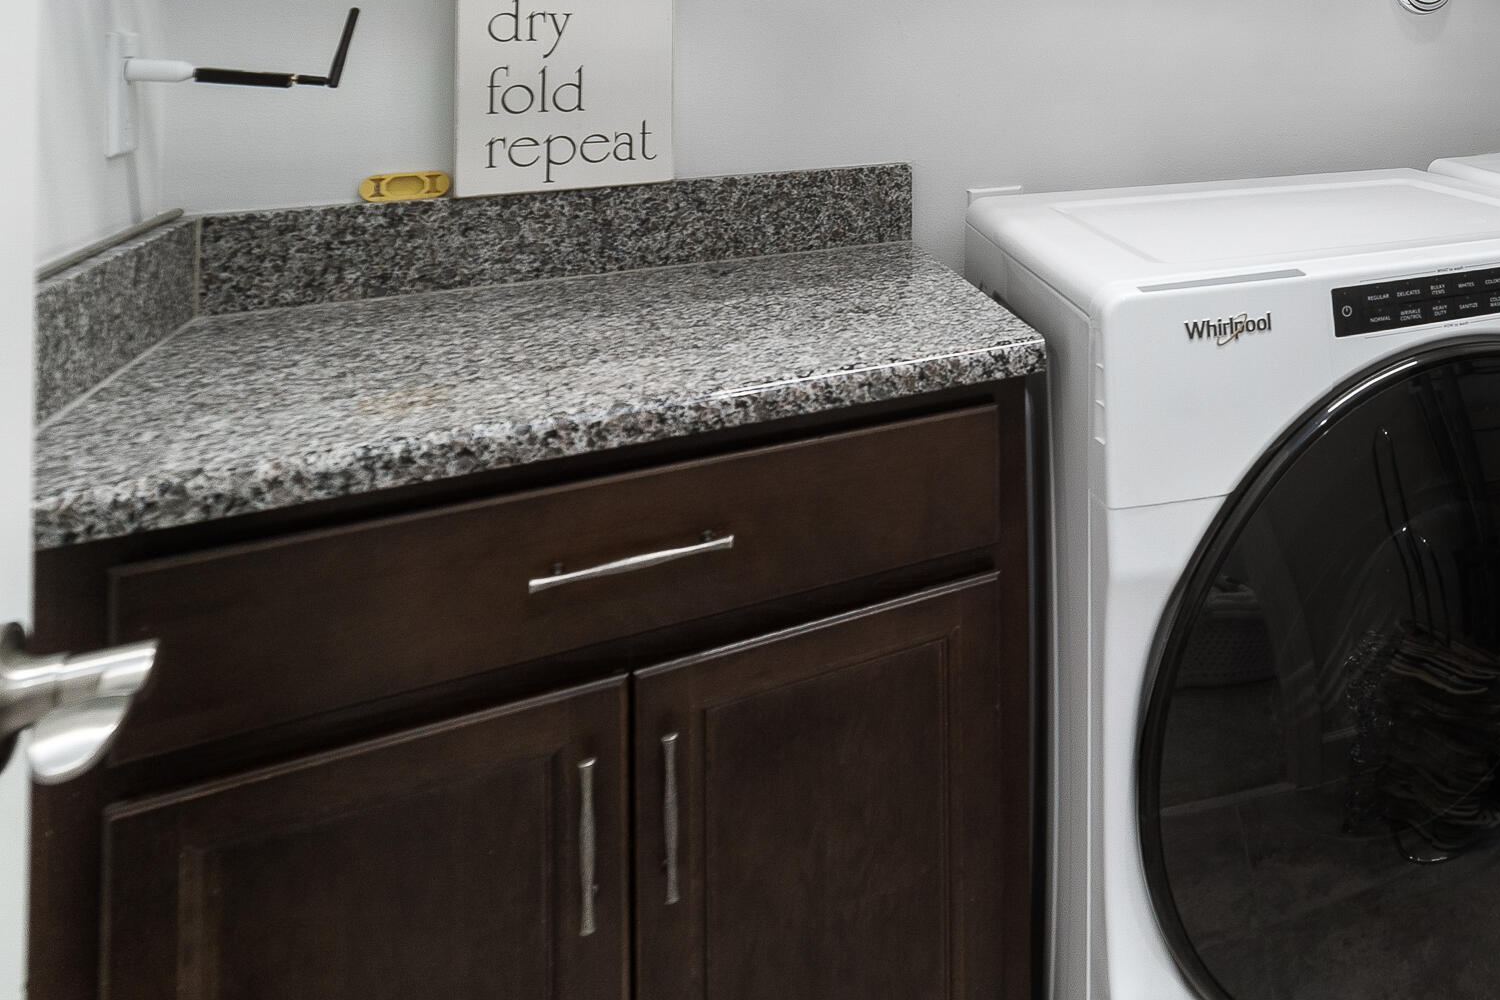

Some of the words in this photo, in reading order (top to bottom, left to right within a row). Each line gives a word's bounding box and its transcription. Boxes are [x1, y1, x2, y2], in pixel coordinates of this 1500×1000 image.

[485, 64, 586, 115] fold
[484, 120, 657, 183] repeat
[1184, 311, 1272, 346] Whirlpool
